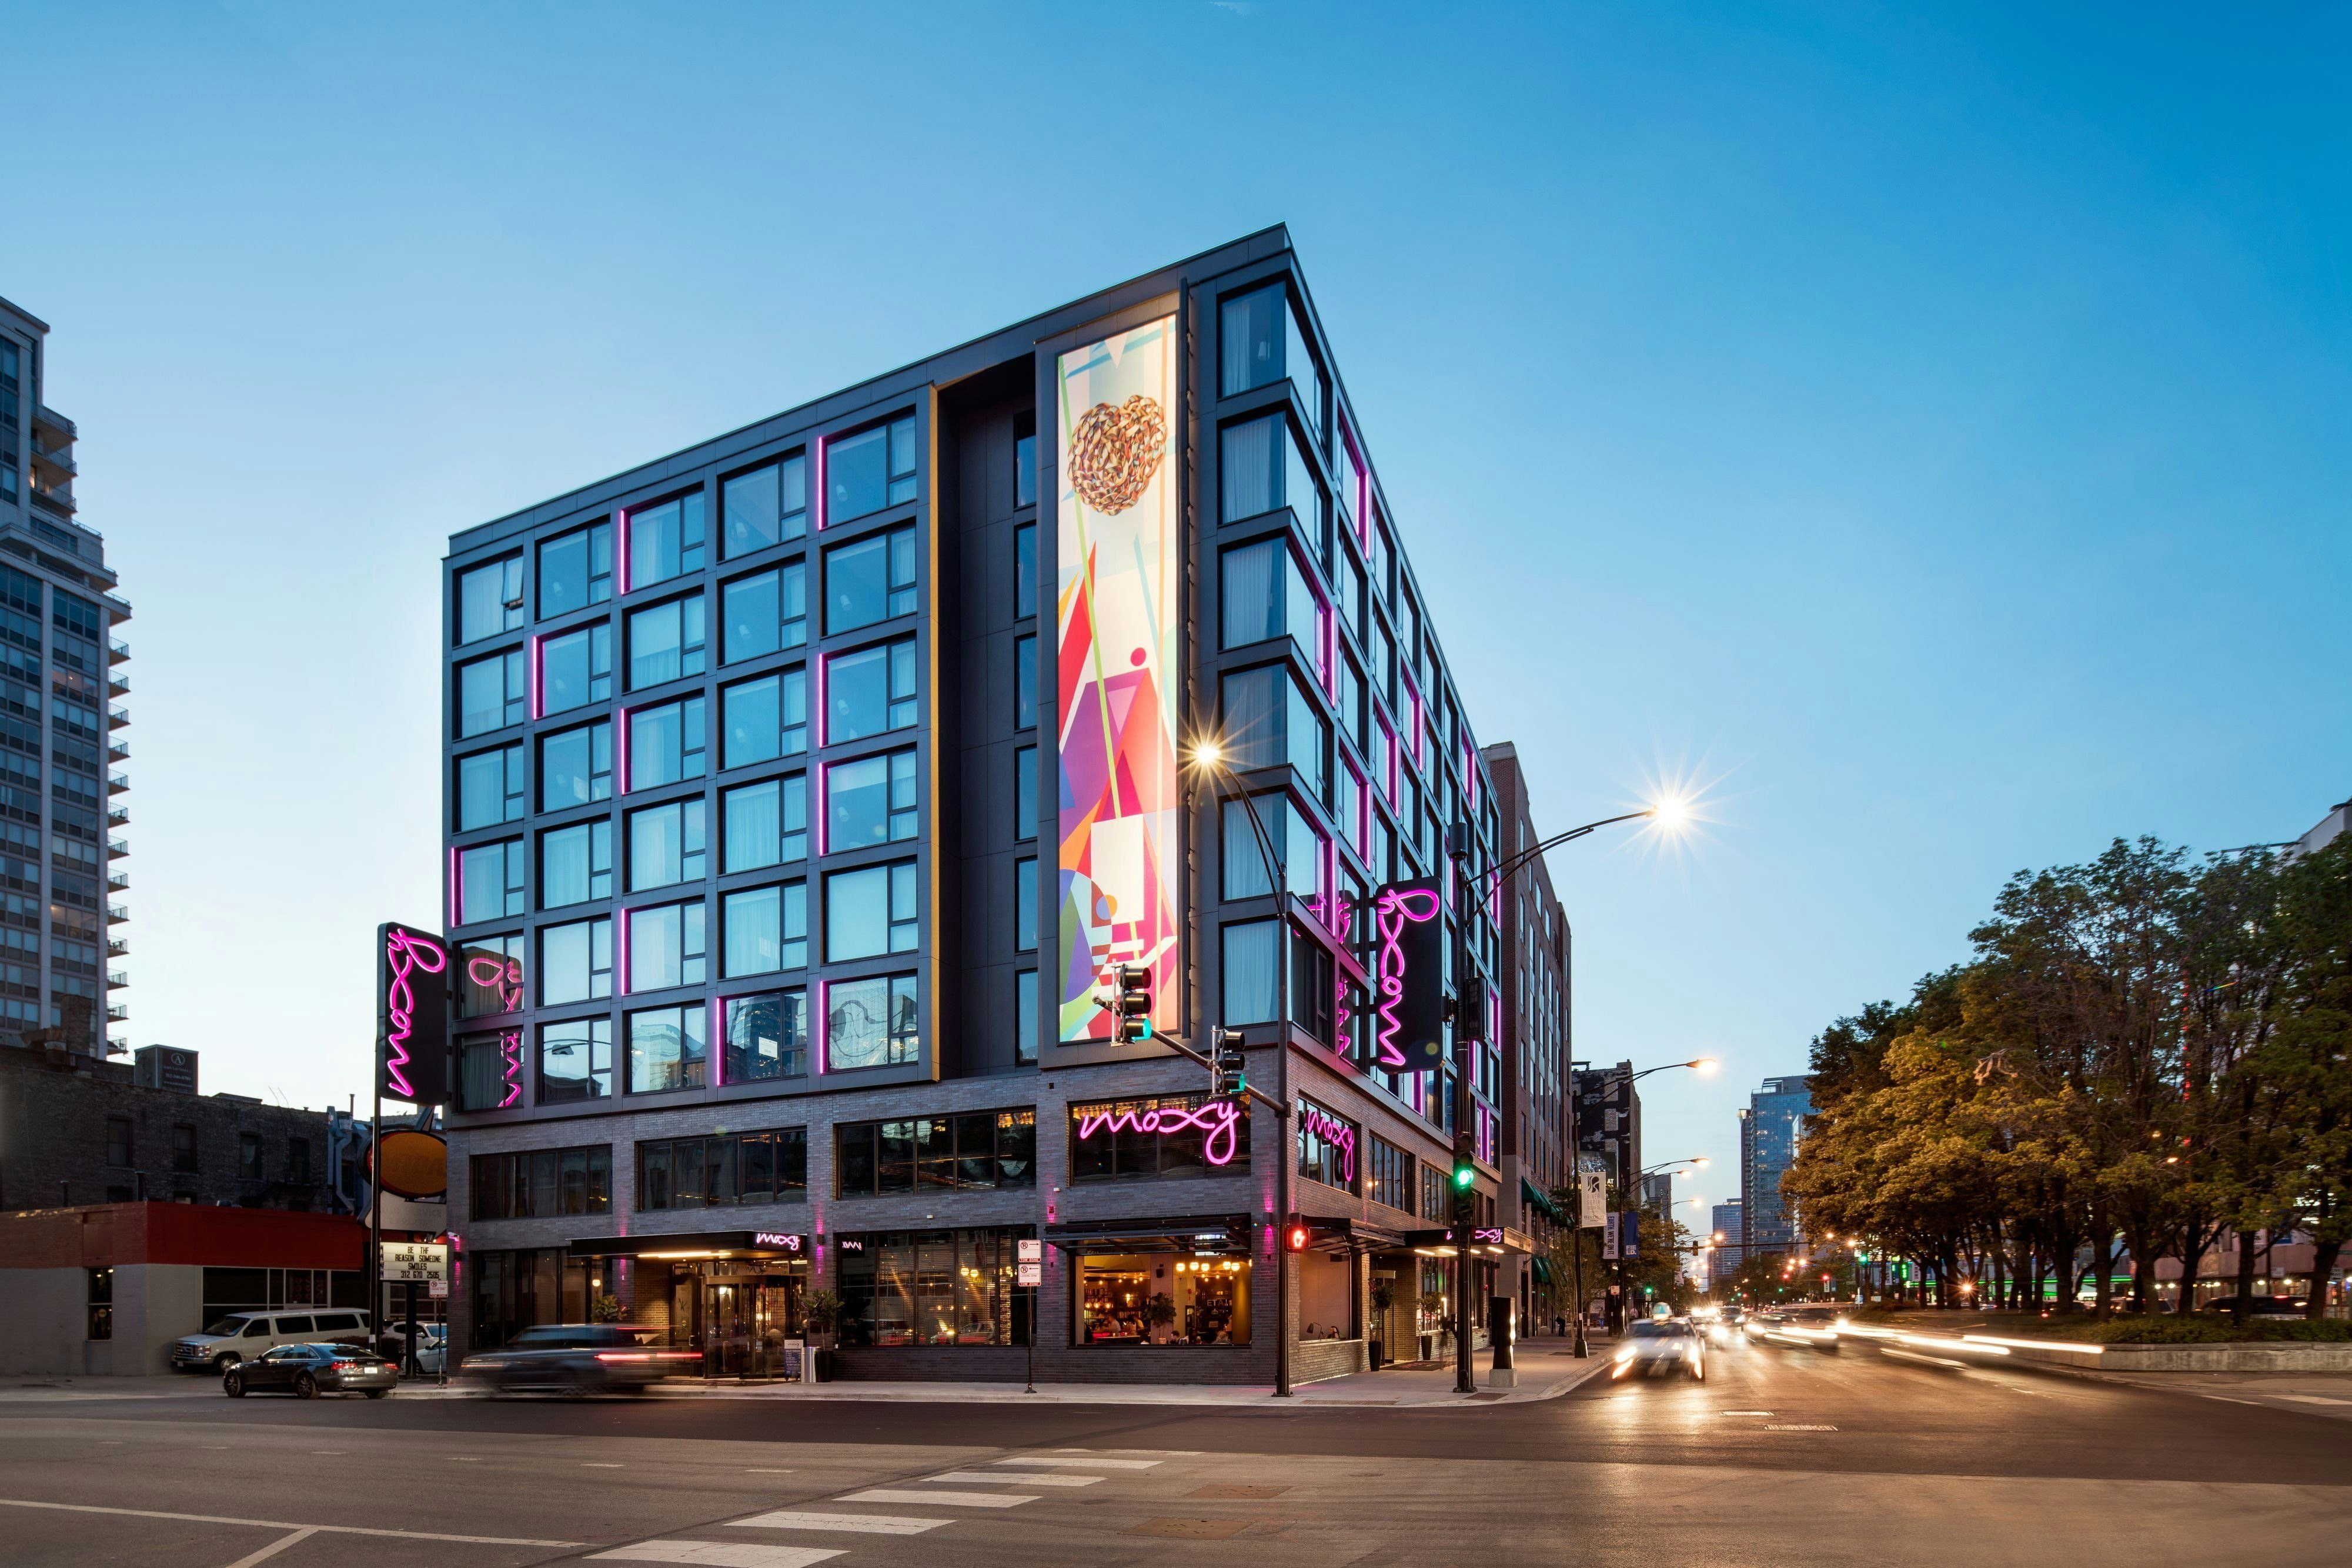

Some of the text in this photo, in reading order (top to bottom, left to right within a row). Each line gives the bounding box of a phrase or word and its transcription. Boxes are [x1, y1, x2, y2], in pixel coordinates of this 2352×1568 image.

[386, 928, 446, 1097] moxy
[1378, 889, 1439, 1066] moxy
[1080, 1102, 1240, 1165] moxy
[1307, 1109, 1355, 1182] moxy
[756, 1233, 800, 1250] moxy
